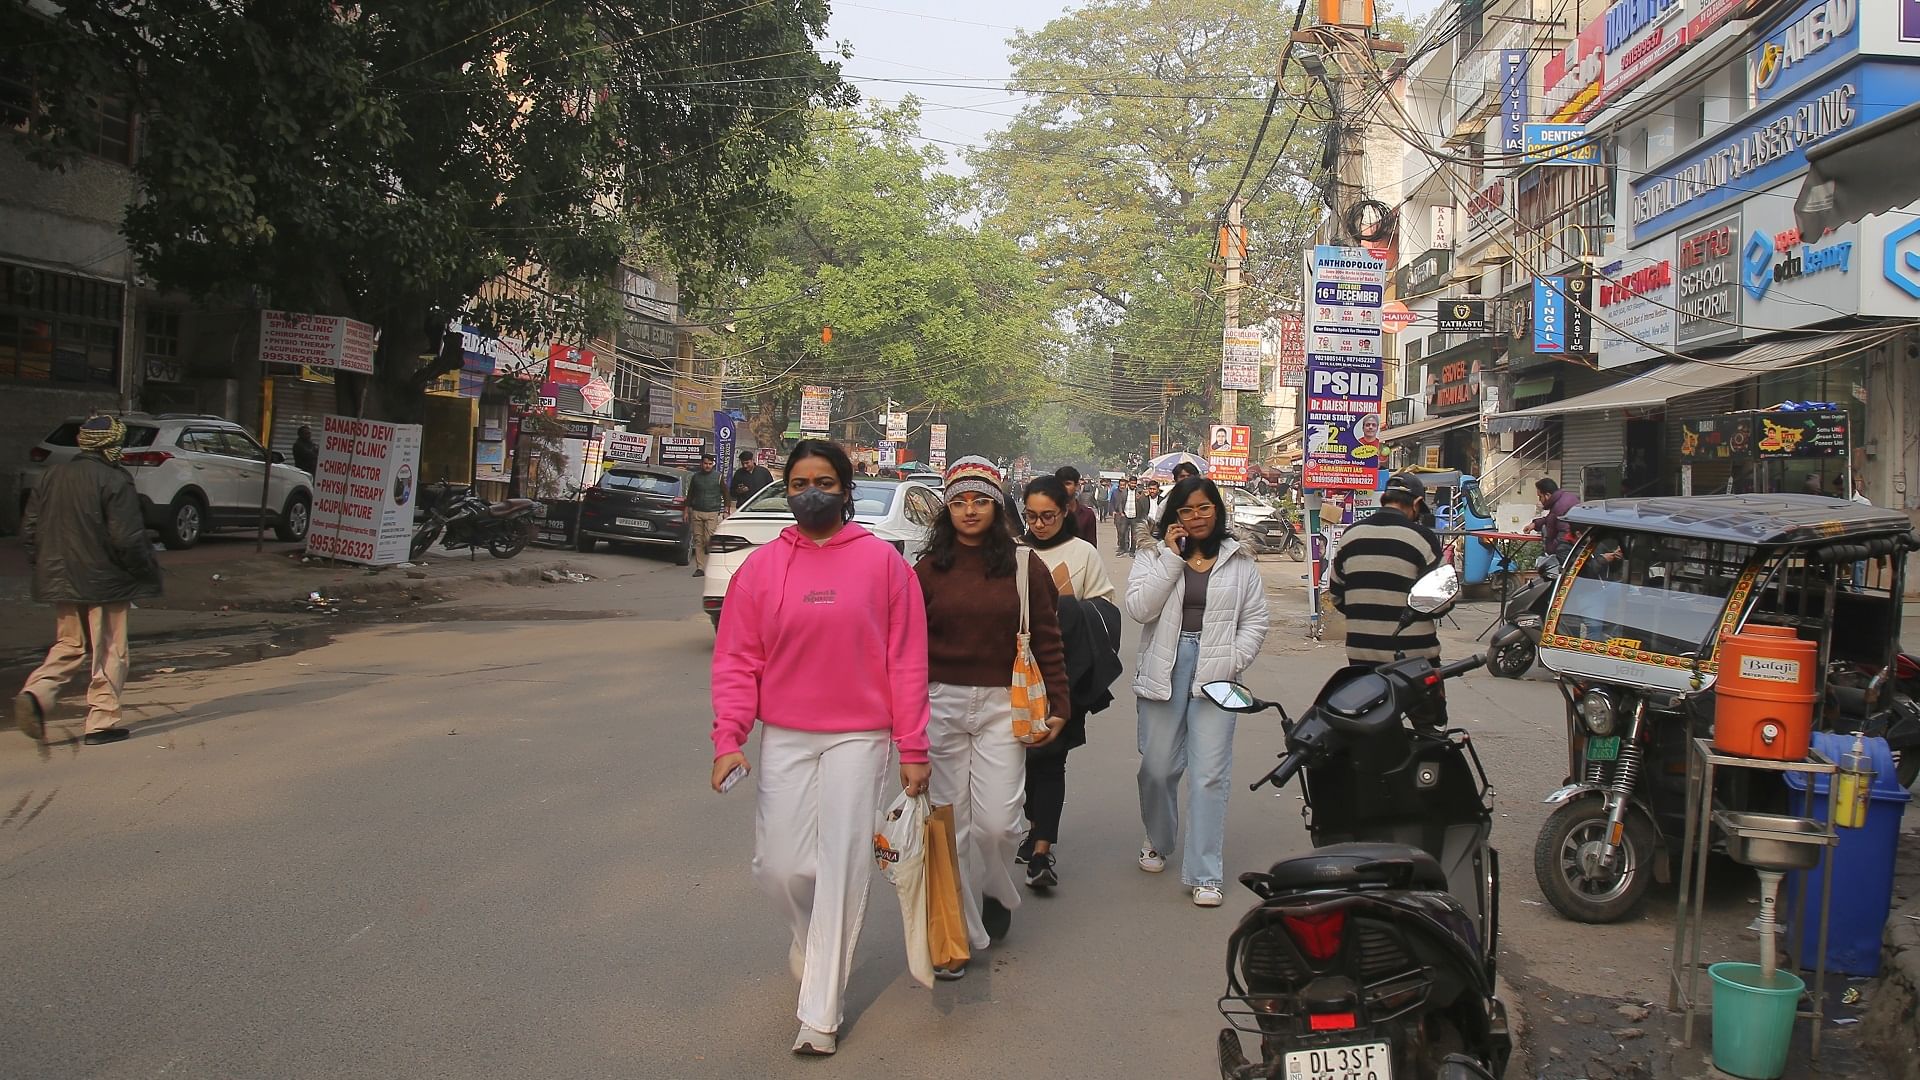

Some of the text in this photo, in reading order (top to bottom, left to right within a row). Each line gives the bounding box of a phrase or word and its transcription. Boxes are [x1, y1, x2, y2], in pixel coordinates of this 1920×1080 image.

[1782, 0, 1856, 69] AHEAD
[1510, 66, 1520, 133] PLUTUS
[1506, 139, 1523, 148] IAS
[1542, 131, 1584, 141] DENTIST
[1632, 84, 1856, 227] DENTAL IMPLANT & LASER CLINIC
[1436, 208, 1444, 240] KALAM
[1680, 226, 1731, 270] METRO
[1318, 260, 1383, 269] ANTHROPOLOGY
[1680, 262, 1728, 297] SCHOOL
[1337, 290, 1378, 302] DECEMBER
[1544, 290, 1555, 340] SINGAL
[1680, 290, 1728, 325] UNIFORM
[270, 321, 333, 333] SPINE CLINIC
[316, 317, 338, 325] DEVI
[270, 331, 330, 341] CHIROPRACTOR
[300, 341, 335, 349] THERAPY
[263, 352, 335, 365] 9953626323
[269, 345, 326, 356] ACUPUNCTURE
[1314, 370, 1378, 396] PSIR
[1442, 361, 1465, 384] GROVER
[1311, 400, 1378, 413] Dr. RAJESH MISHRA
[324, 417, 394, 442] BANARSO DEVI
[620, 434, 637, 443] SUNYA
[326, 436, 354, 450] SPINE
[355, 441, 387, 459] CLINIC
[324, 460, 381, 481] CHIROPRACTOR
[1210, 456, 1246, 466] HISTORY
[321, 480, 384, 502] PHYSIO THERAPY
[319, 498, 372, 520] ACUPUNCTURE
[310, 533, 374, 560] 9953626323
[1616, 664, 1646, 678] yatri
[1750, 660, 1792, 674] Balaji
[1310, 1046, 1375, 1073] DL3SF
